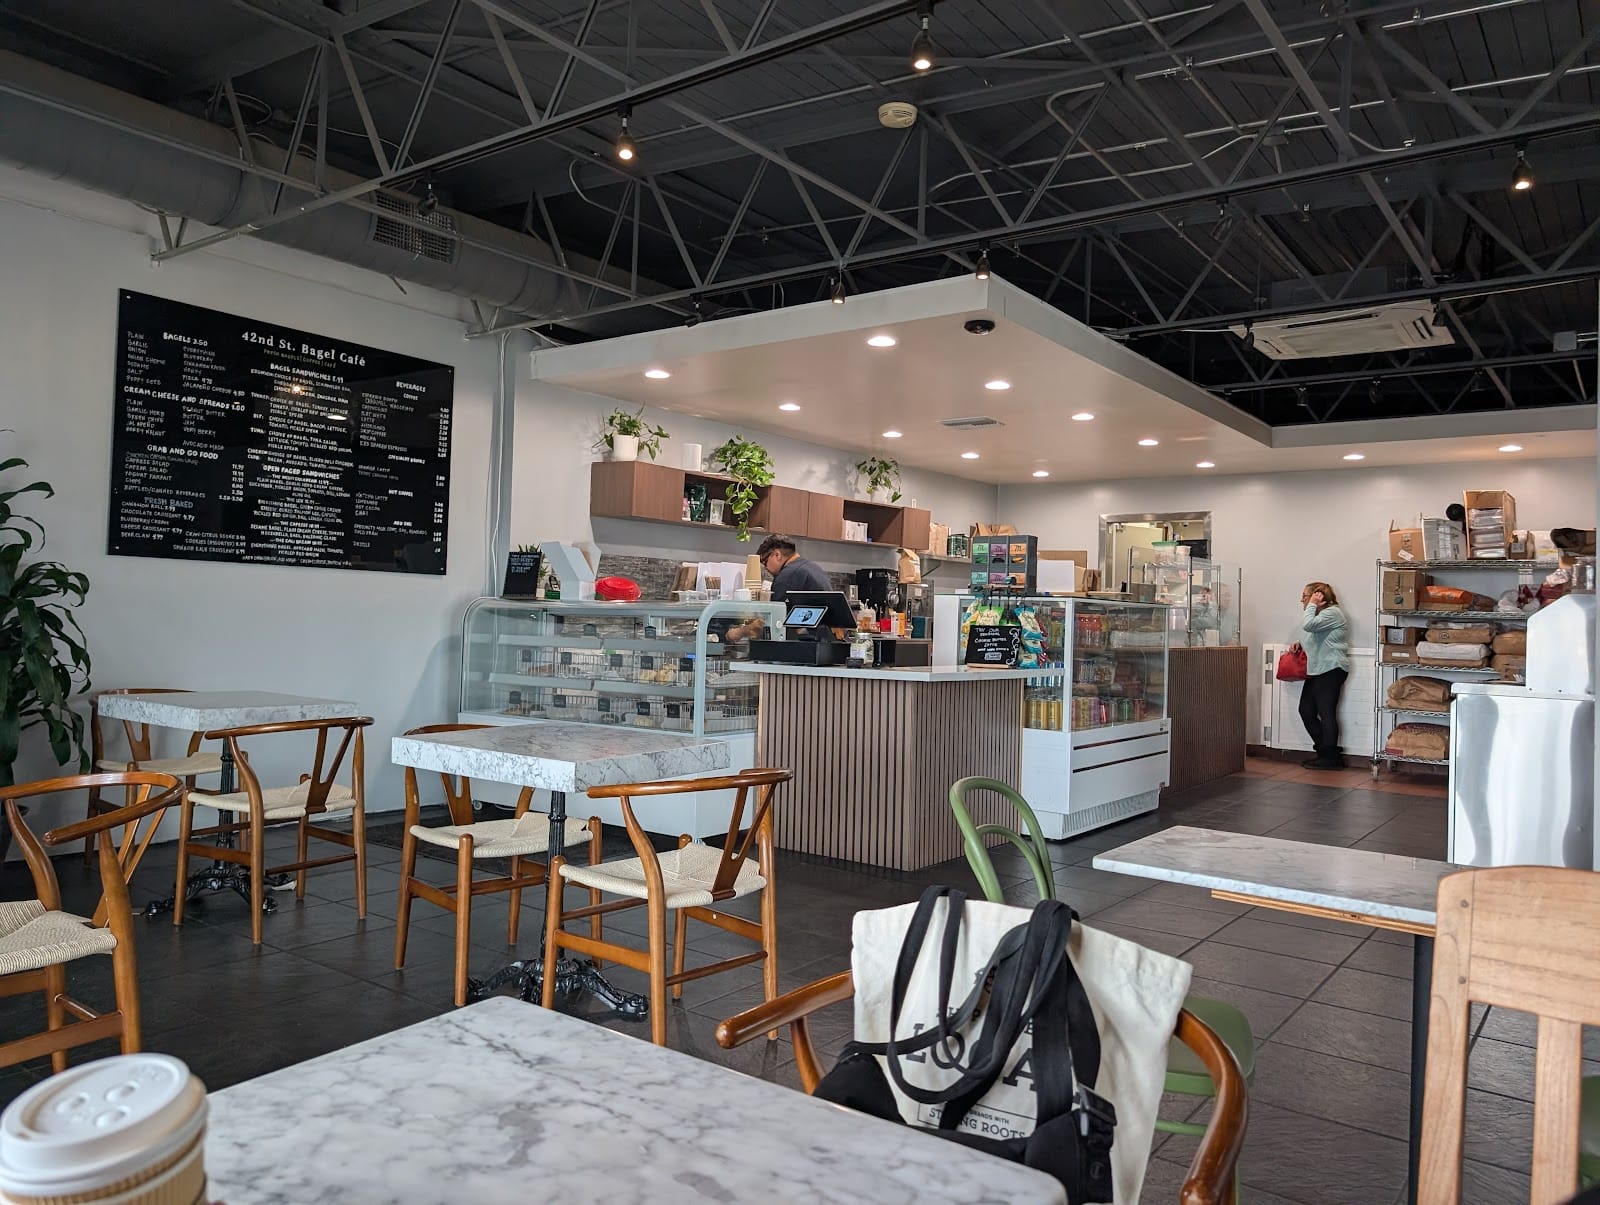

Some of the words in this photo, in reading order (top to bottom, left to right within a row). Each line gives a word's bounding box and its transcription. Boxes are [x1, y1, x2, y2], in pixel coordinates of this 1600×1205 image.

[163, 332, 191, 343] BAGELS
[128, 339, 148, 348] GARLIC
[128, 346, 146, 354] ONION
[242, 332, 273, 346] 42nd
[279, 339, 295, 351] St.
[302, 344, 335, 360] Bagel
[340, 353, 365, 366] Café
[270, 363, 290, 372] BAGEL
[292, 368, 331, 381] SANDWICHES
[396, 381, 426, 392] BEVERAGES
[124, 386, 150, 395] CREAM
[152, 391, 179, 401] CHEESE
[199, 398, 230, 409] SPREADS
[127, 406, 148, 414] GARLIC
[198, 429, 216, 437] BERRY
[147, 444, 167, 453] GRAB
[182, 440, 208, 448] AVOCADO
[281, 467, 300, 475] FACED
[302, 470, 339, 479] SANDWICHES
[144, 497, 167, 505] FRESH
[170, 499, 193, 508] BAKED
[121, 508, 152, 516] CHOCOLATE
[120, 516, 150, 524] BLUEBERRY
[929, 1107, 977, 1130] STNG
[995, 1116, 1009, 1124] WITH
